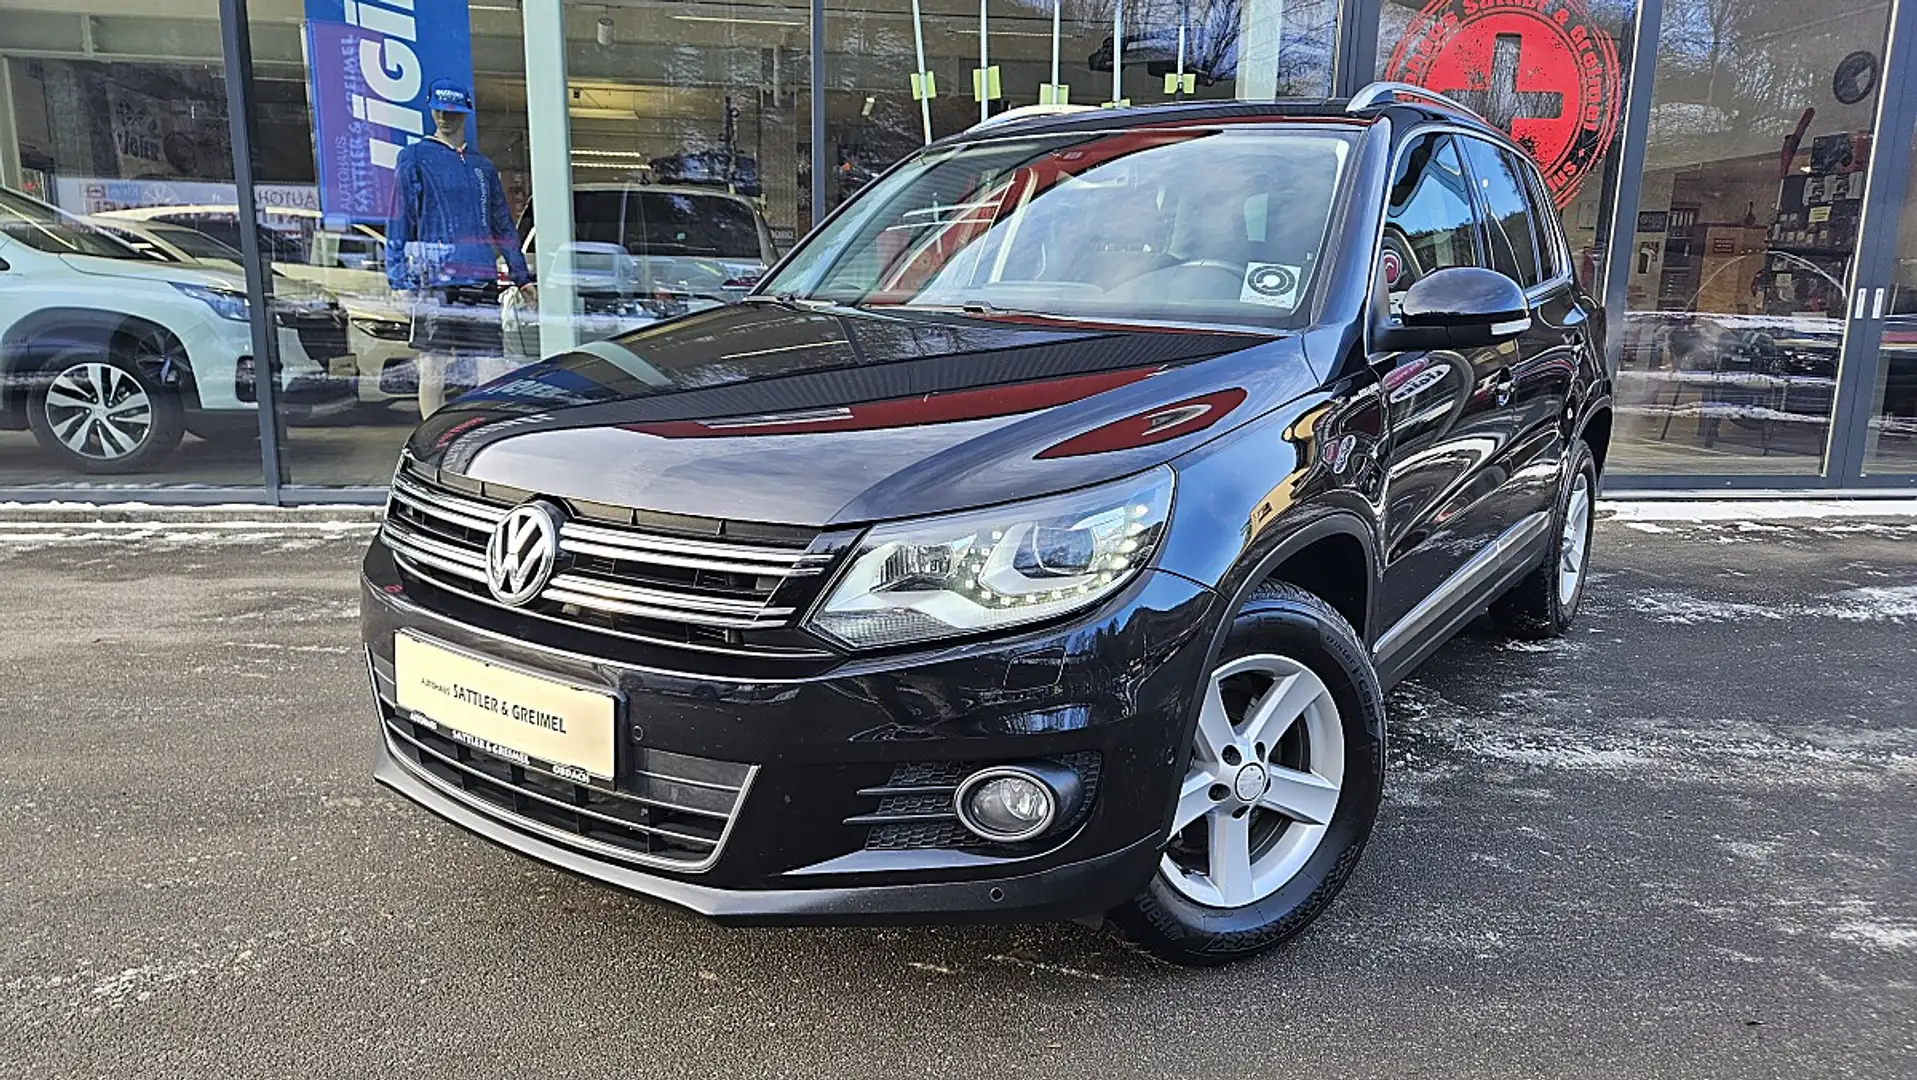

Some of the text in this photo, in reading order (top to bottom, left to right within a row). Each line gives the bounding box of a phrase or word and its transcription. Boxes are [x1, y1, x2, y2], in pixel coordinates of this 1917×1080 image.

[1553, 8, 1570, 25] &
[1570, 24, 1601, 131] Greimel
[421, 677, 567, 734] AUTOHAUS SATTLER & GREIMEL
[452, 730, 485, 750] SATTLER
[492, 744, 530, 765] GREIMEL
